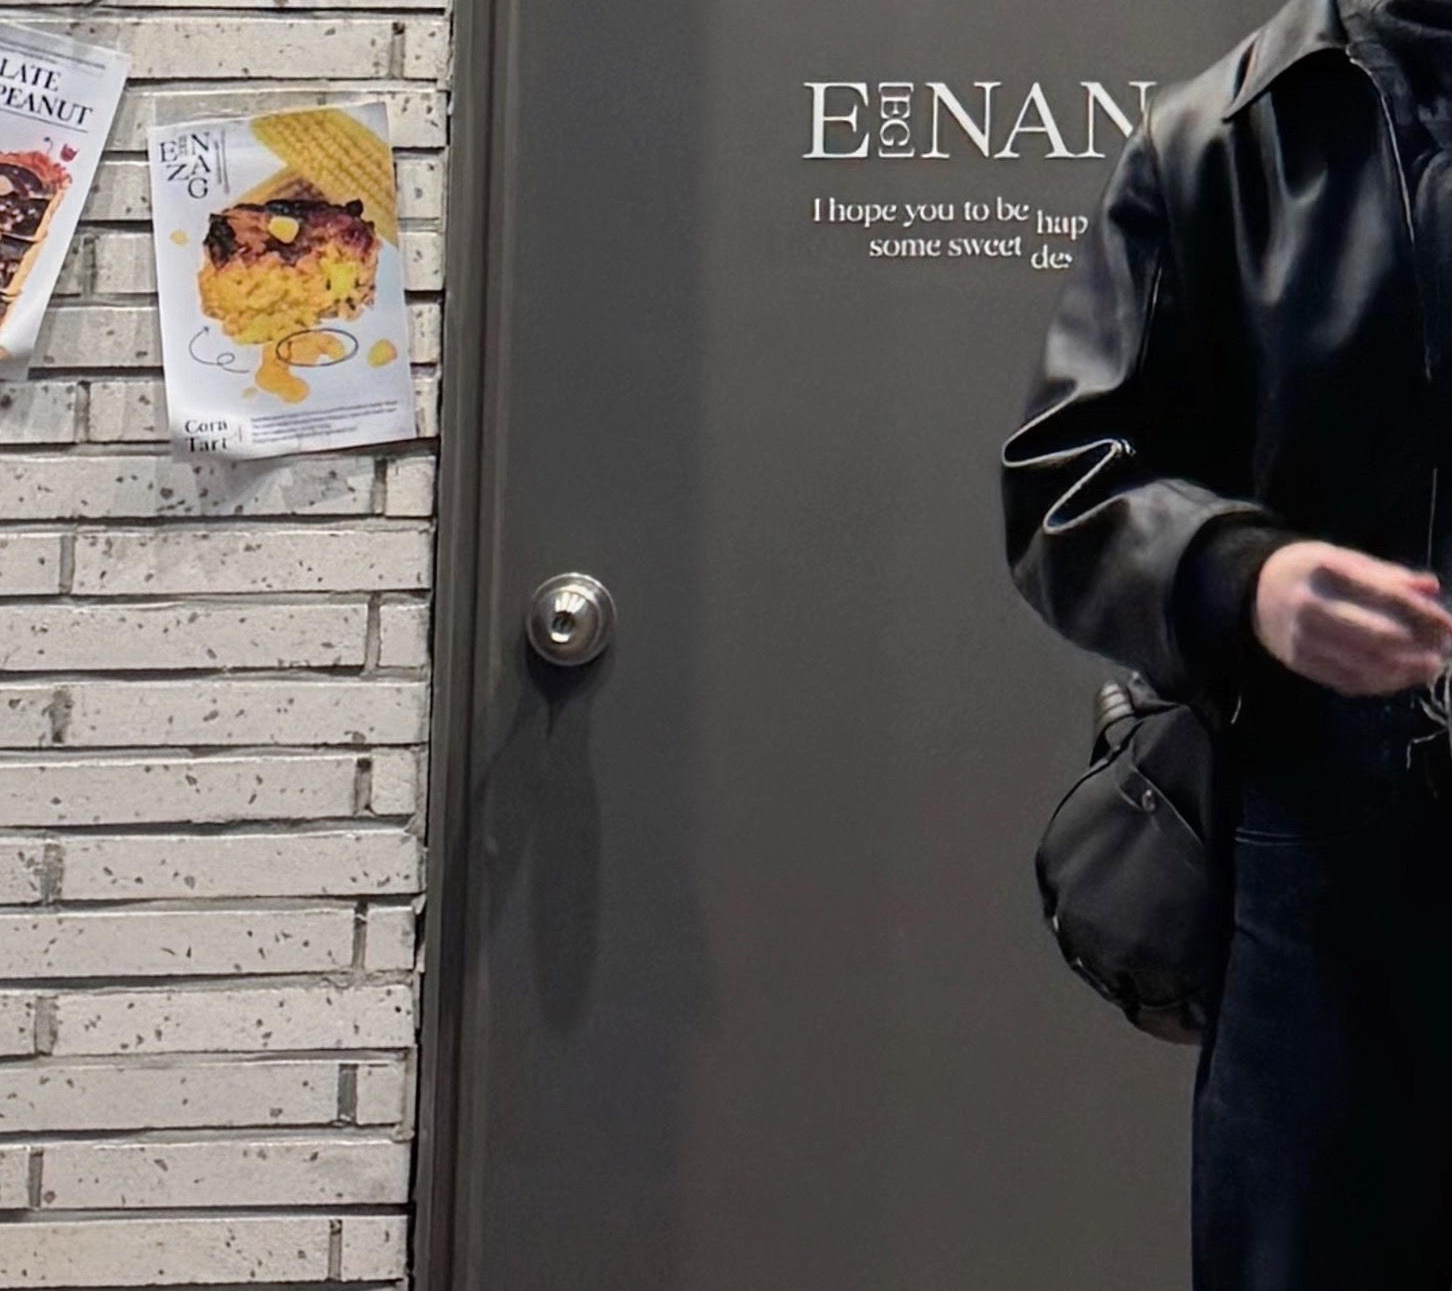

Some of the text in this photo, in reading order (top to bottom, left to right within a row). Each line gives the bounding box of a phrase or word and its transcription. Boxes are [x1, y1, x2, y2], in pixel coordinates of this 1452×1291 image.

[0, 58, 61, 92] LATE
[813, 196, 1089, 241] I hope you to be hap
[869, 236, 941, 258] some
[948, 234, 1023, 258] sweet
